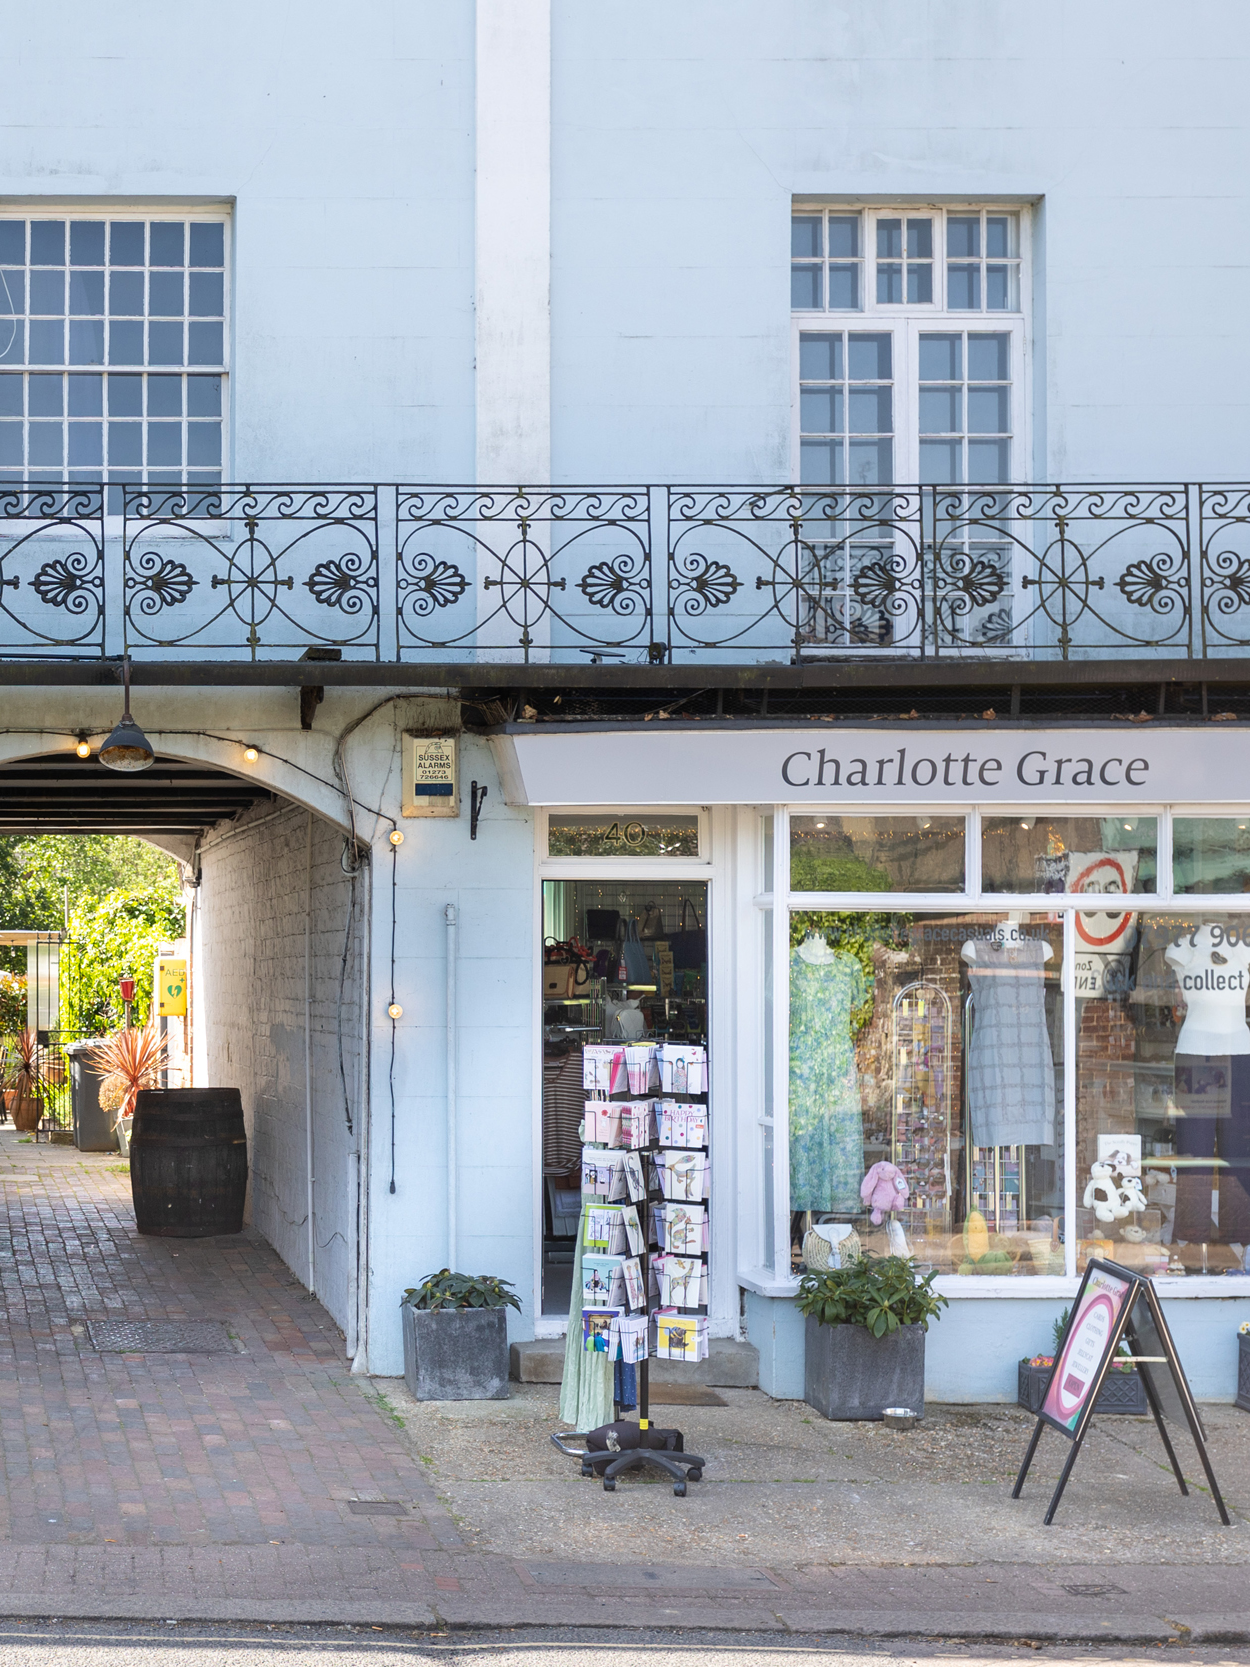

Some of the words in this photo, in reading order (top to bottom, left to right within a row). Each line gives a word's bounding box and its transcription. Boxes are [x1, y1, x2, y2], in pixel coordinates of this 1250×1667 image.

[418, 754, 450, 762] SUSSEX
[780, 747, 1003, 788] Charlotte
[1015, 750, 1151, 788] Grace
[603, 821, 647, 847] 40
[164, 968, 185, 977] AED
[1183, 969, 1245, 991] collect
